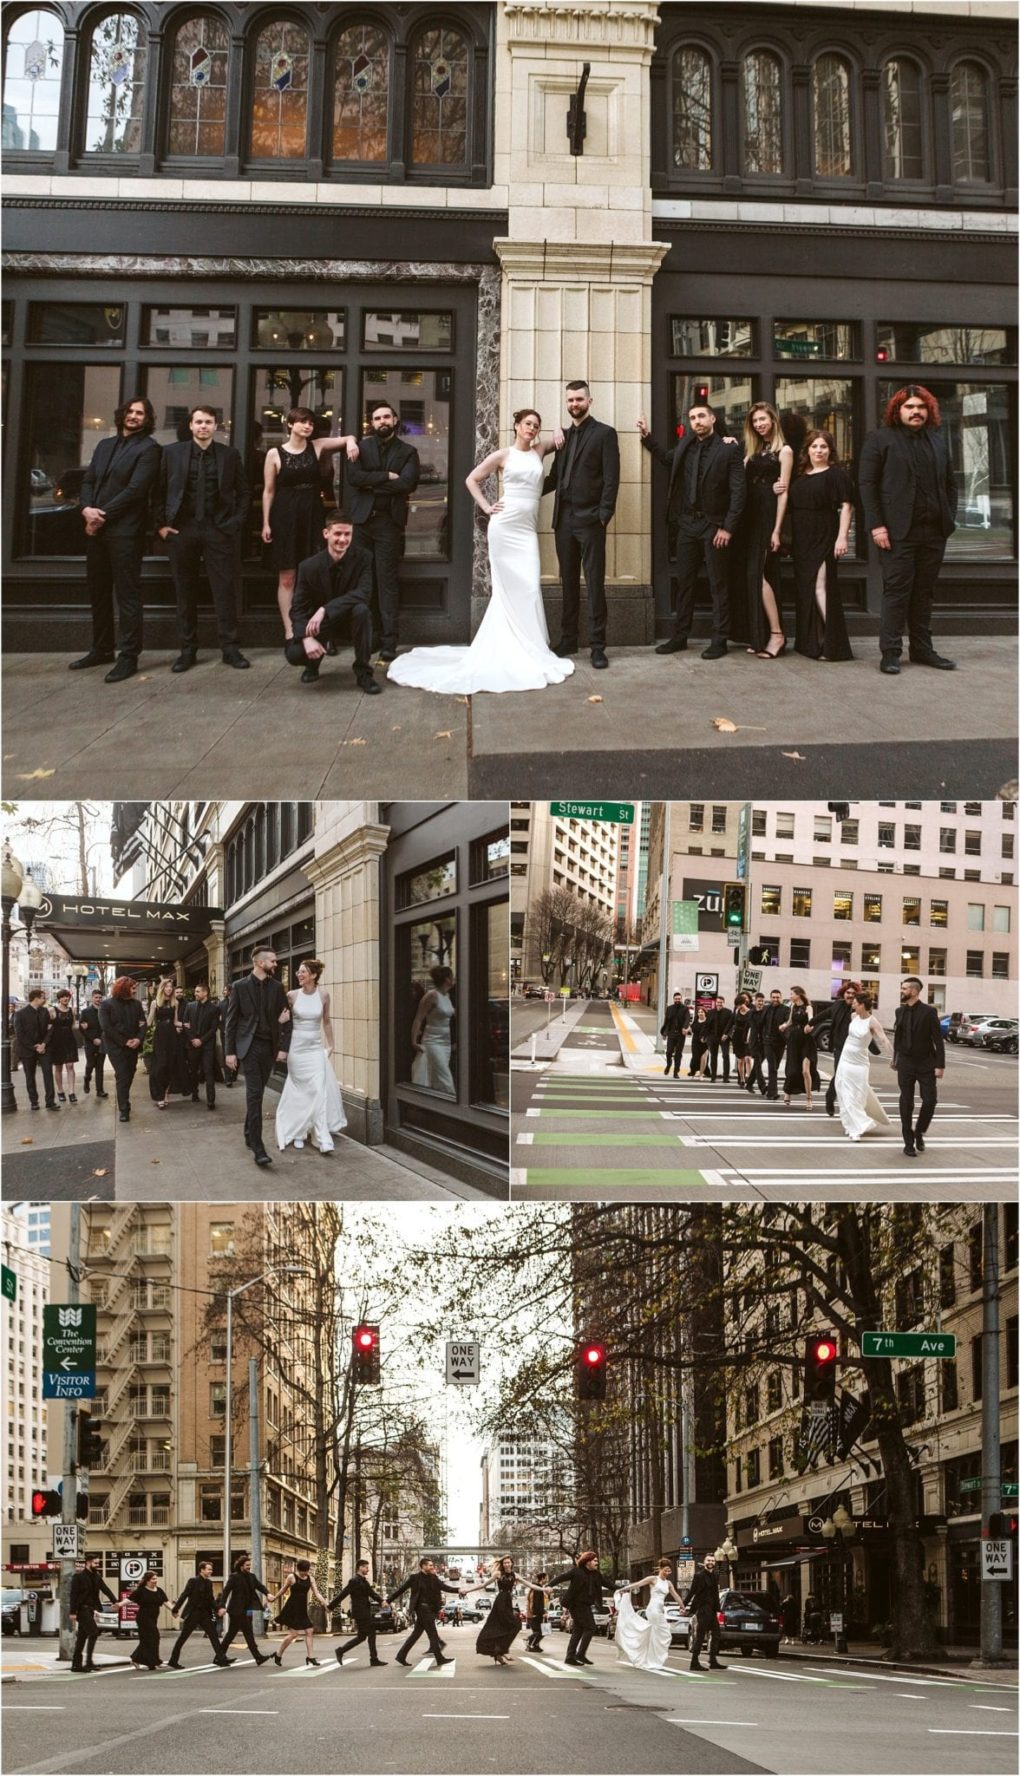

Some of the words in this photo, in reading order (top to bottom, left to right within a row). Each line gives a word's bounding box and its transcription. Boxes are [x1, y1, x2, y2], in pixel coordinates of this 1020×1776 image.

[558, 802, 603, 816] Stewart
[619, 810, 629, 819] St
[62, 904, 141, 918] HOTEL
[146, 910, 190, 921] MAX
[745, 970, 760, 979] ONE
[743, 978, 759, 986] WAY
[61, 1329, 79, 1338] The
[47, 1337, 92, 1346] Convention
[872, 1338, 894, 1351] 7th
[920, 1340, 945, 1351] Ave
[55, 1345, 84, 1354] Center
[451, 1345, 474, 1356] ONE
[450, 1356, 474, 1367] WAY
[48, 1374, 90, 1385] VISITOR
[55, 1385, 83, 1397] INFO
[55, 1526, 75, 1536] ONE
[55, 1536, 76, 1545] WAY
[986, 1543, 1007, 1552] ONE
[985, 1553, 1008, 1563] WAY
